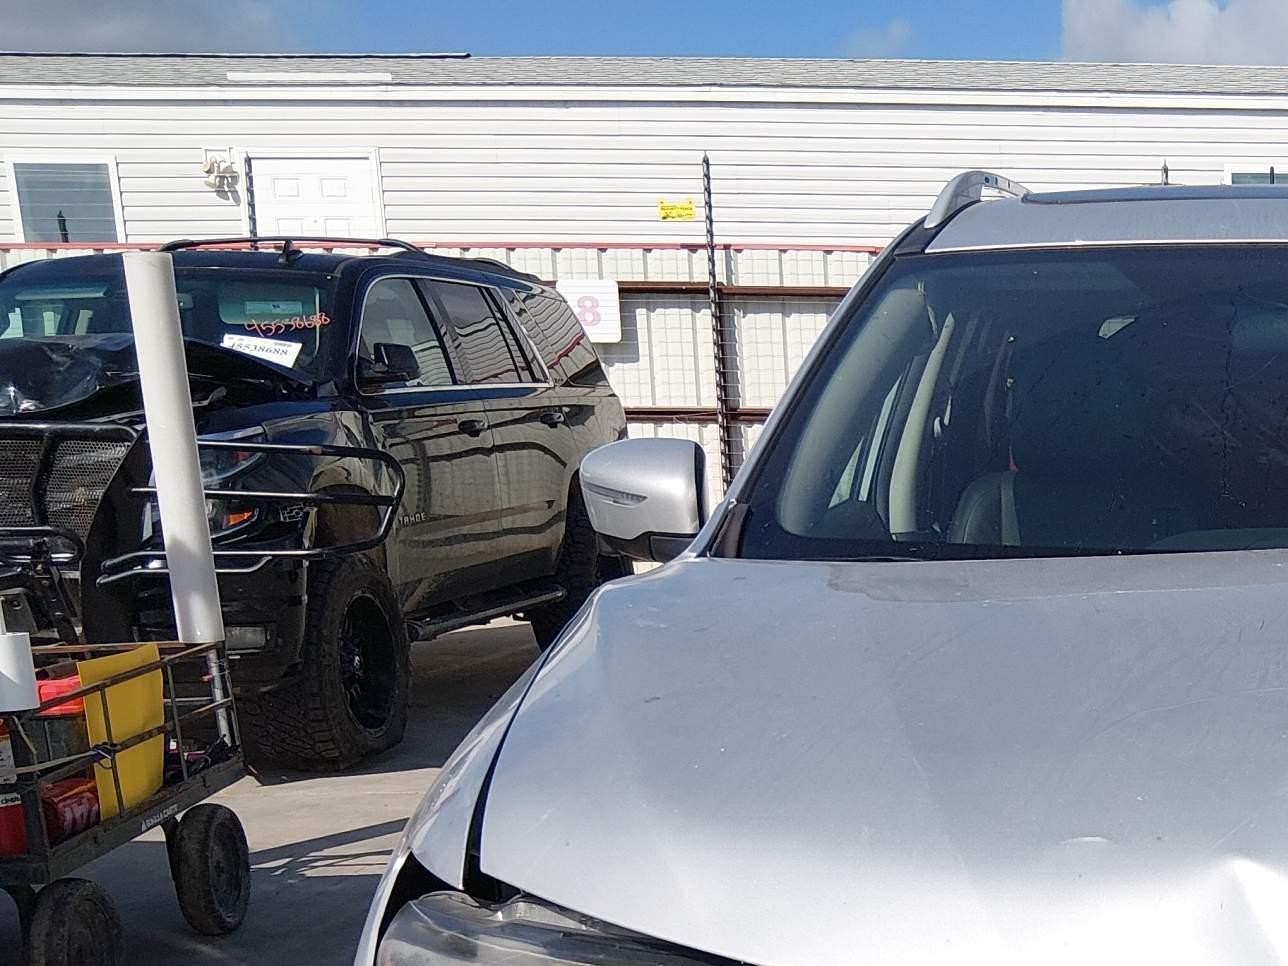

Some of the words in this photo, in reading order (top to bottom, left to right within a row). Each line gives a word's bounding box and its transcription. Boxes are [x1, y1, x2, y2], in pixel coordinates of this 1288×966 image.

[576, 295, 602, 327] 8
[228, 342, 289, 357] 45538688
[399, 512, 426, 526] TAHOE
